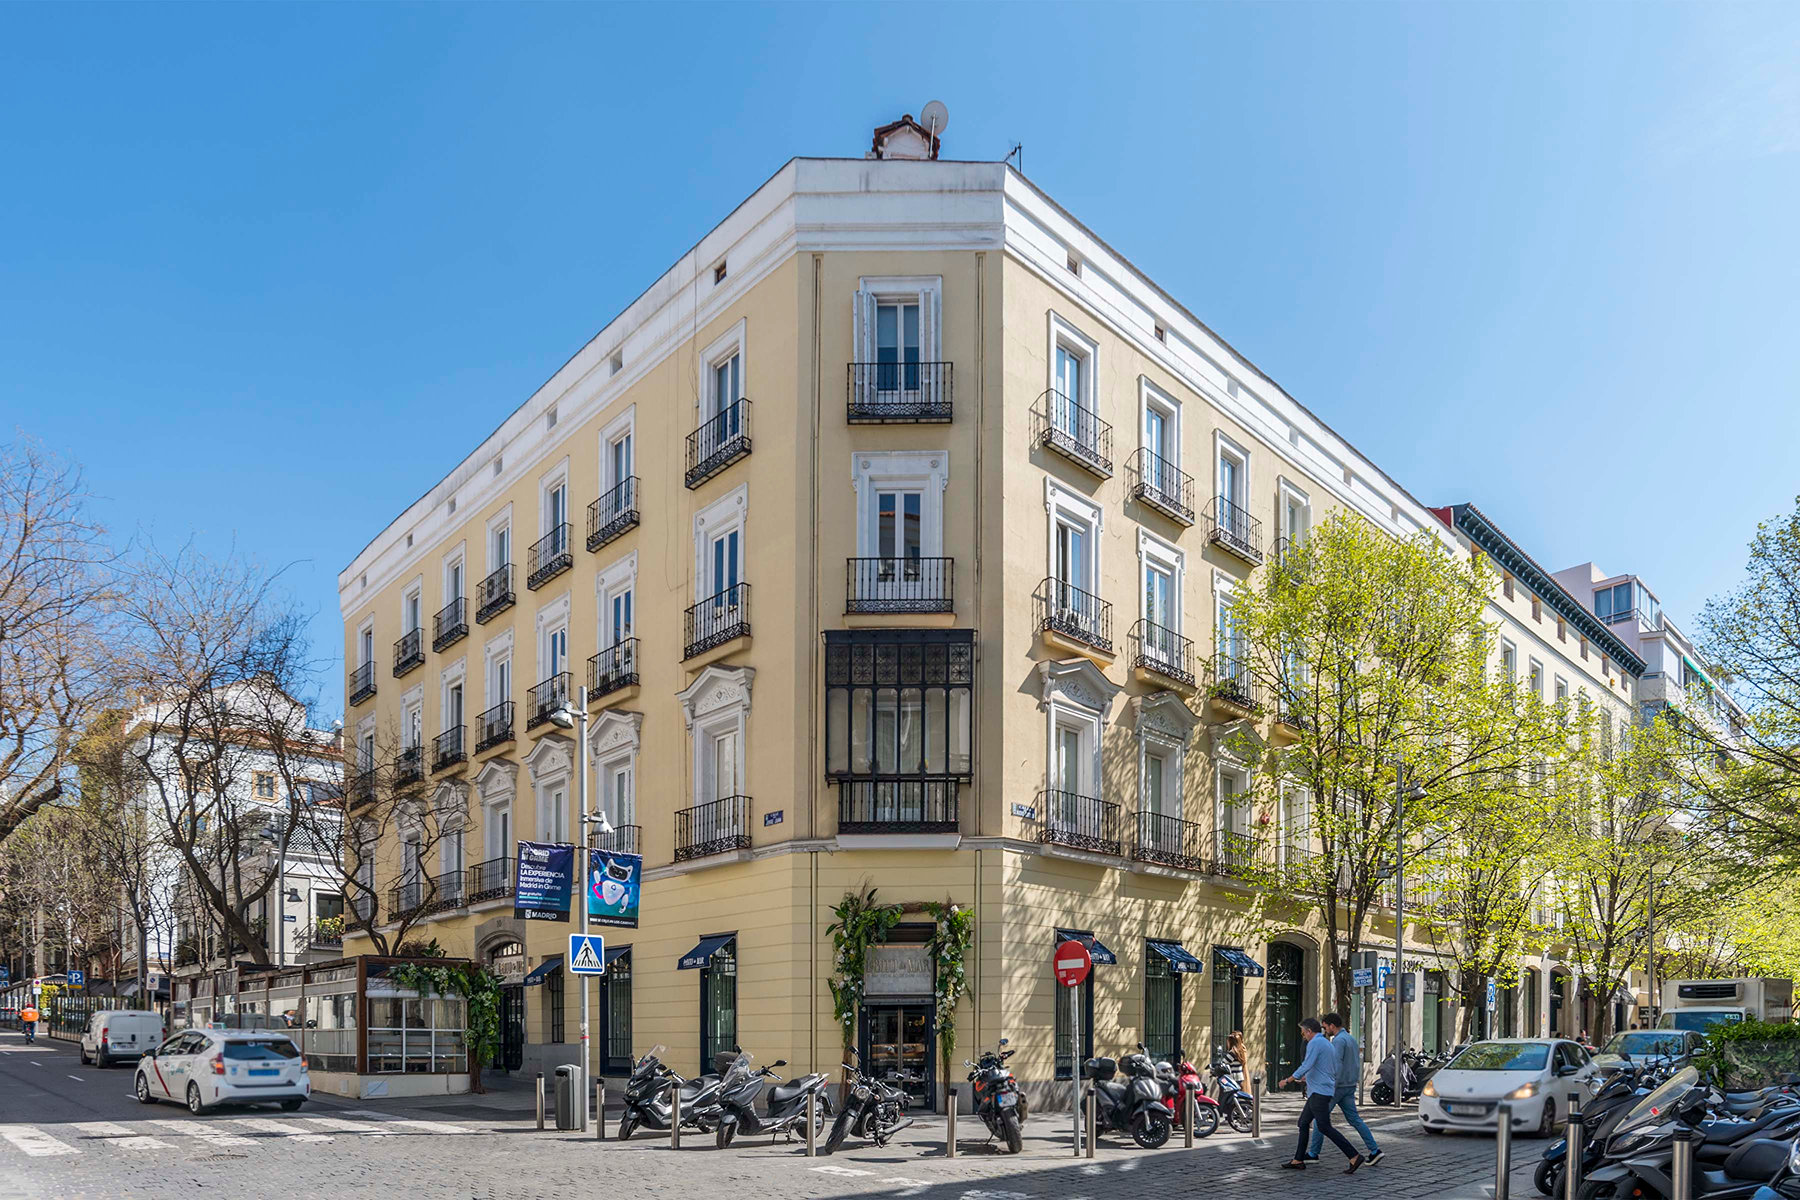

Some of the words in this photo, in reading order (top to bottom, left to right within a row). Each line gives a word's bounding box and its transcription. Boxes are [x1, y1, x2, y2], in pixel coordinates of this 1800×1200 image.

[520, 862, 547, 870] Descubre
[528, 870, 565, 879] EXPERIENCIA
[519, 882, 538, 890] Madrid
[544, 883, 562, 891] Game
[531, 911, 558, 920] MADRID
